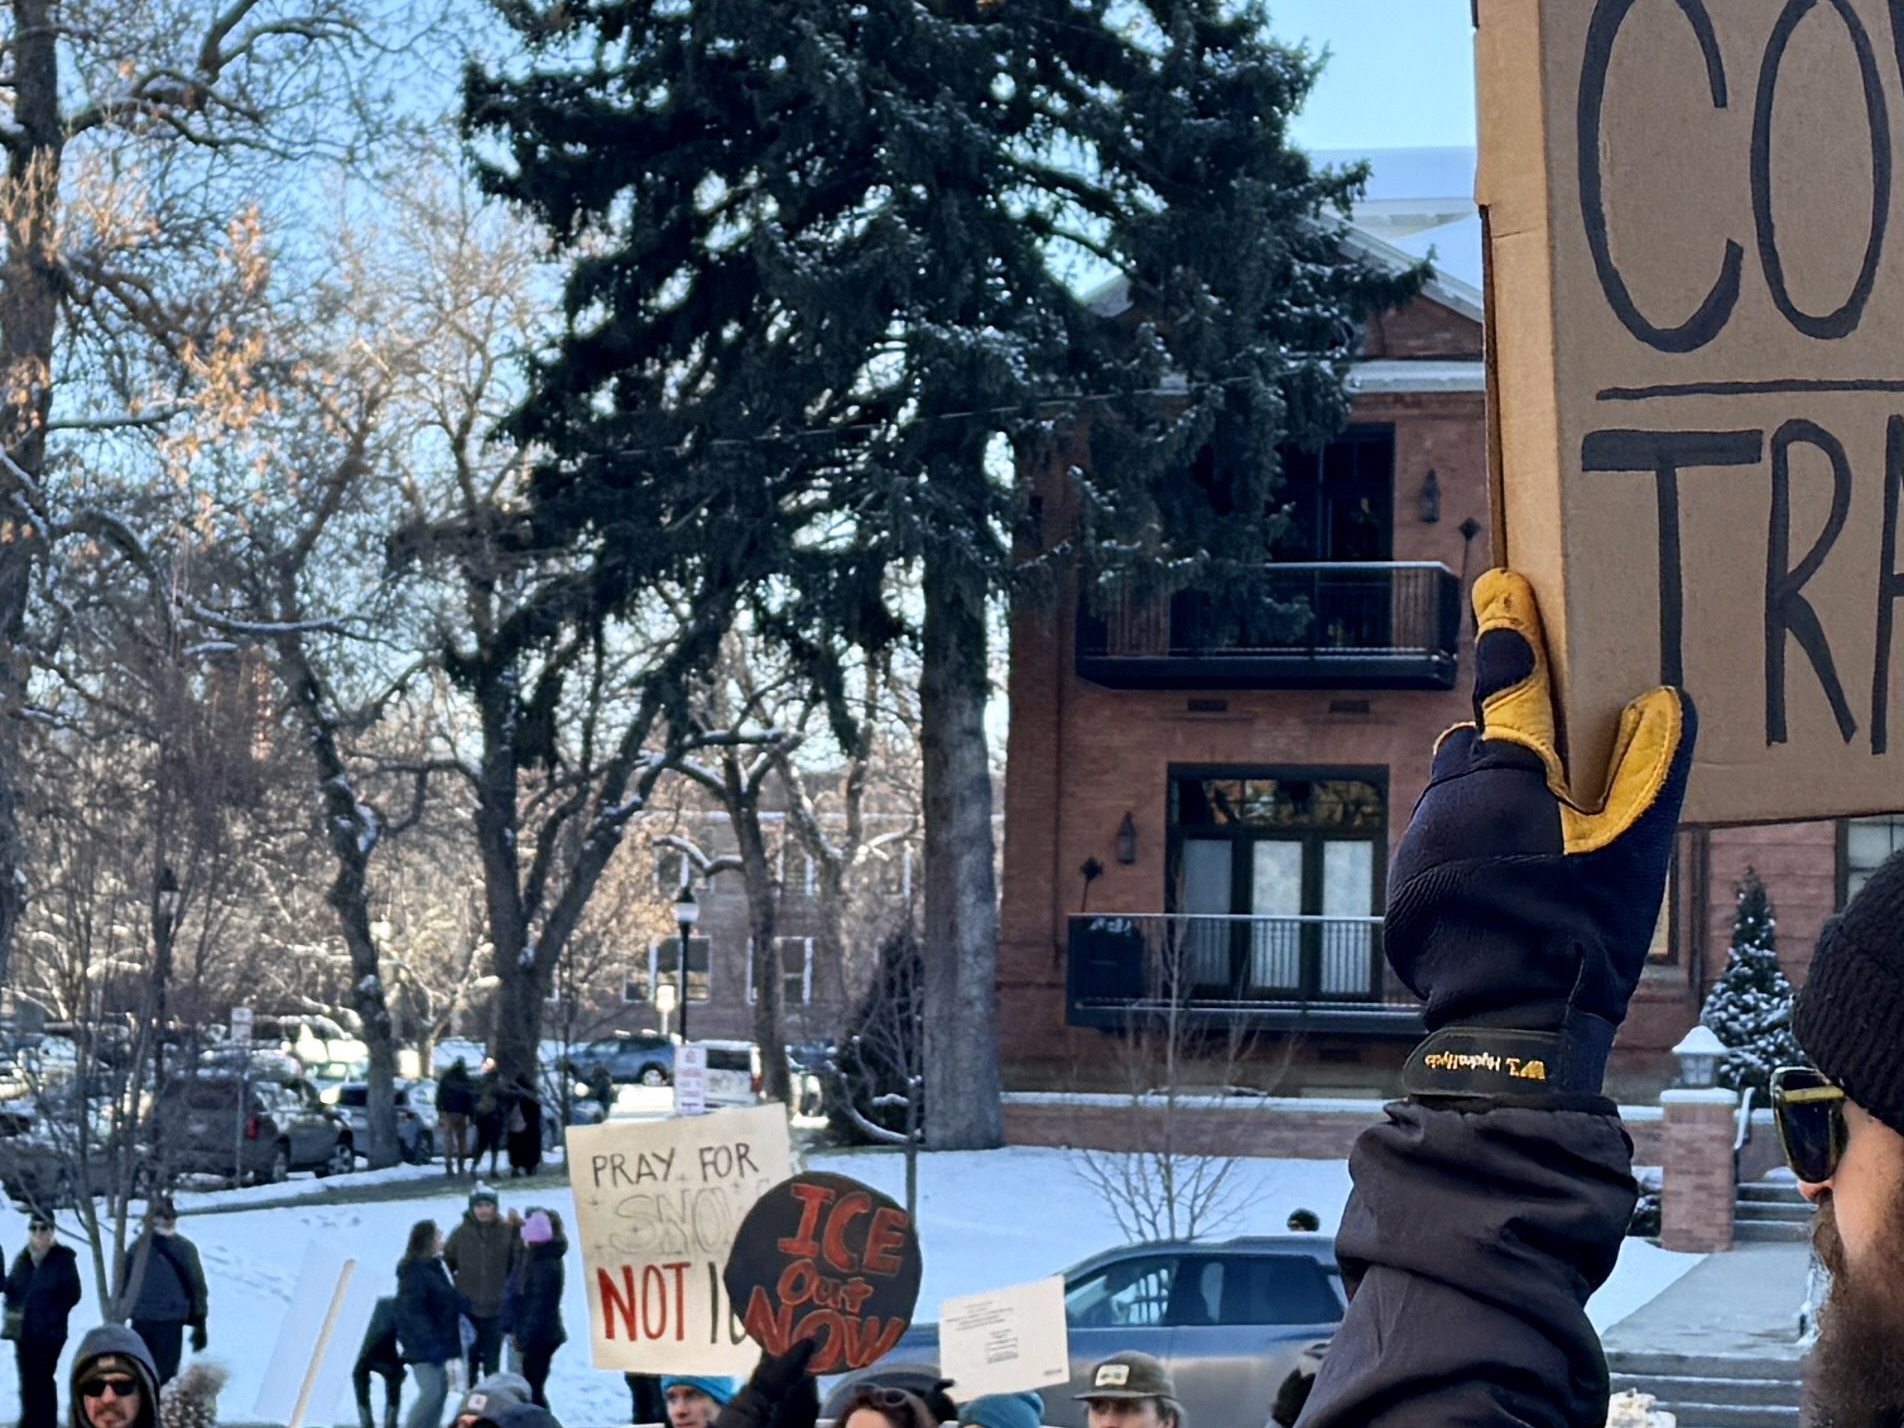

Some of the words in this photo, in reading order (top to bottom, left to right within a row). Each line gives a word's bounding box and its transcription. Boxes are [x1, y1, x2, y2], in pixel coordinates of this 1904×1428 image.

[591, 1147, 676, 1188] PRAY
[698, 1142, 760, 1183] FOR
[608, 1187, 737, 1256] SNO
[777, 1182, 912, 1276] ICE
[597, 1261, 692, 1342] NOT
[745, 1285, 906, 1373] NOW
